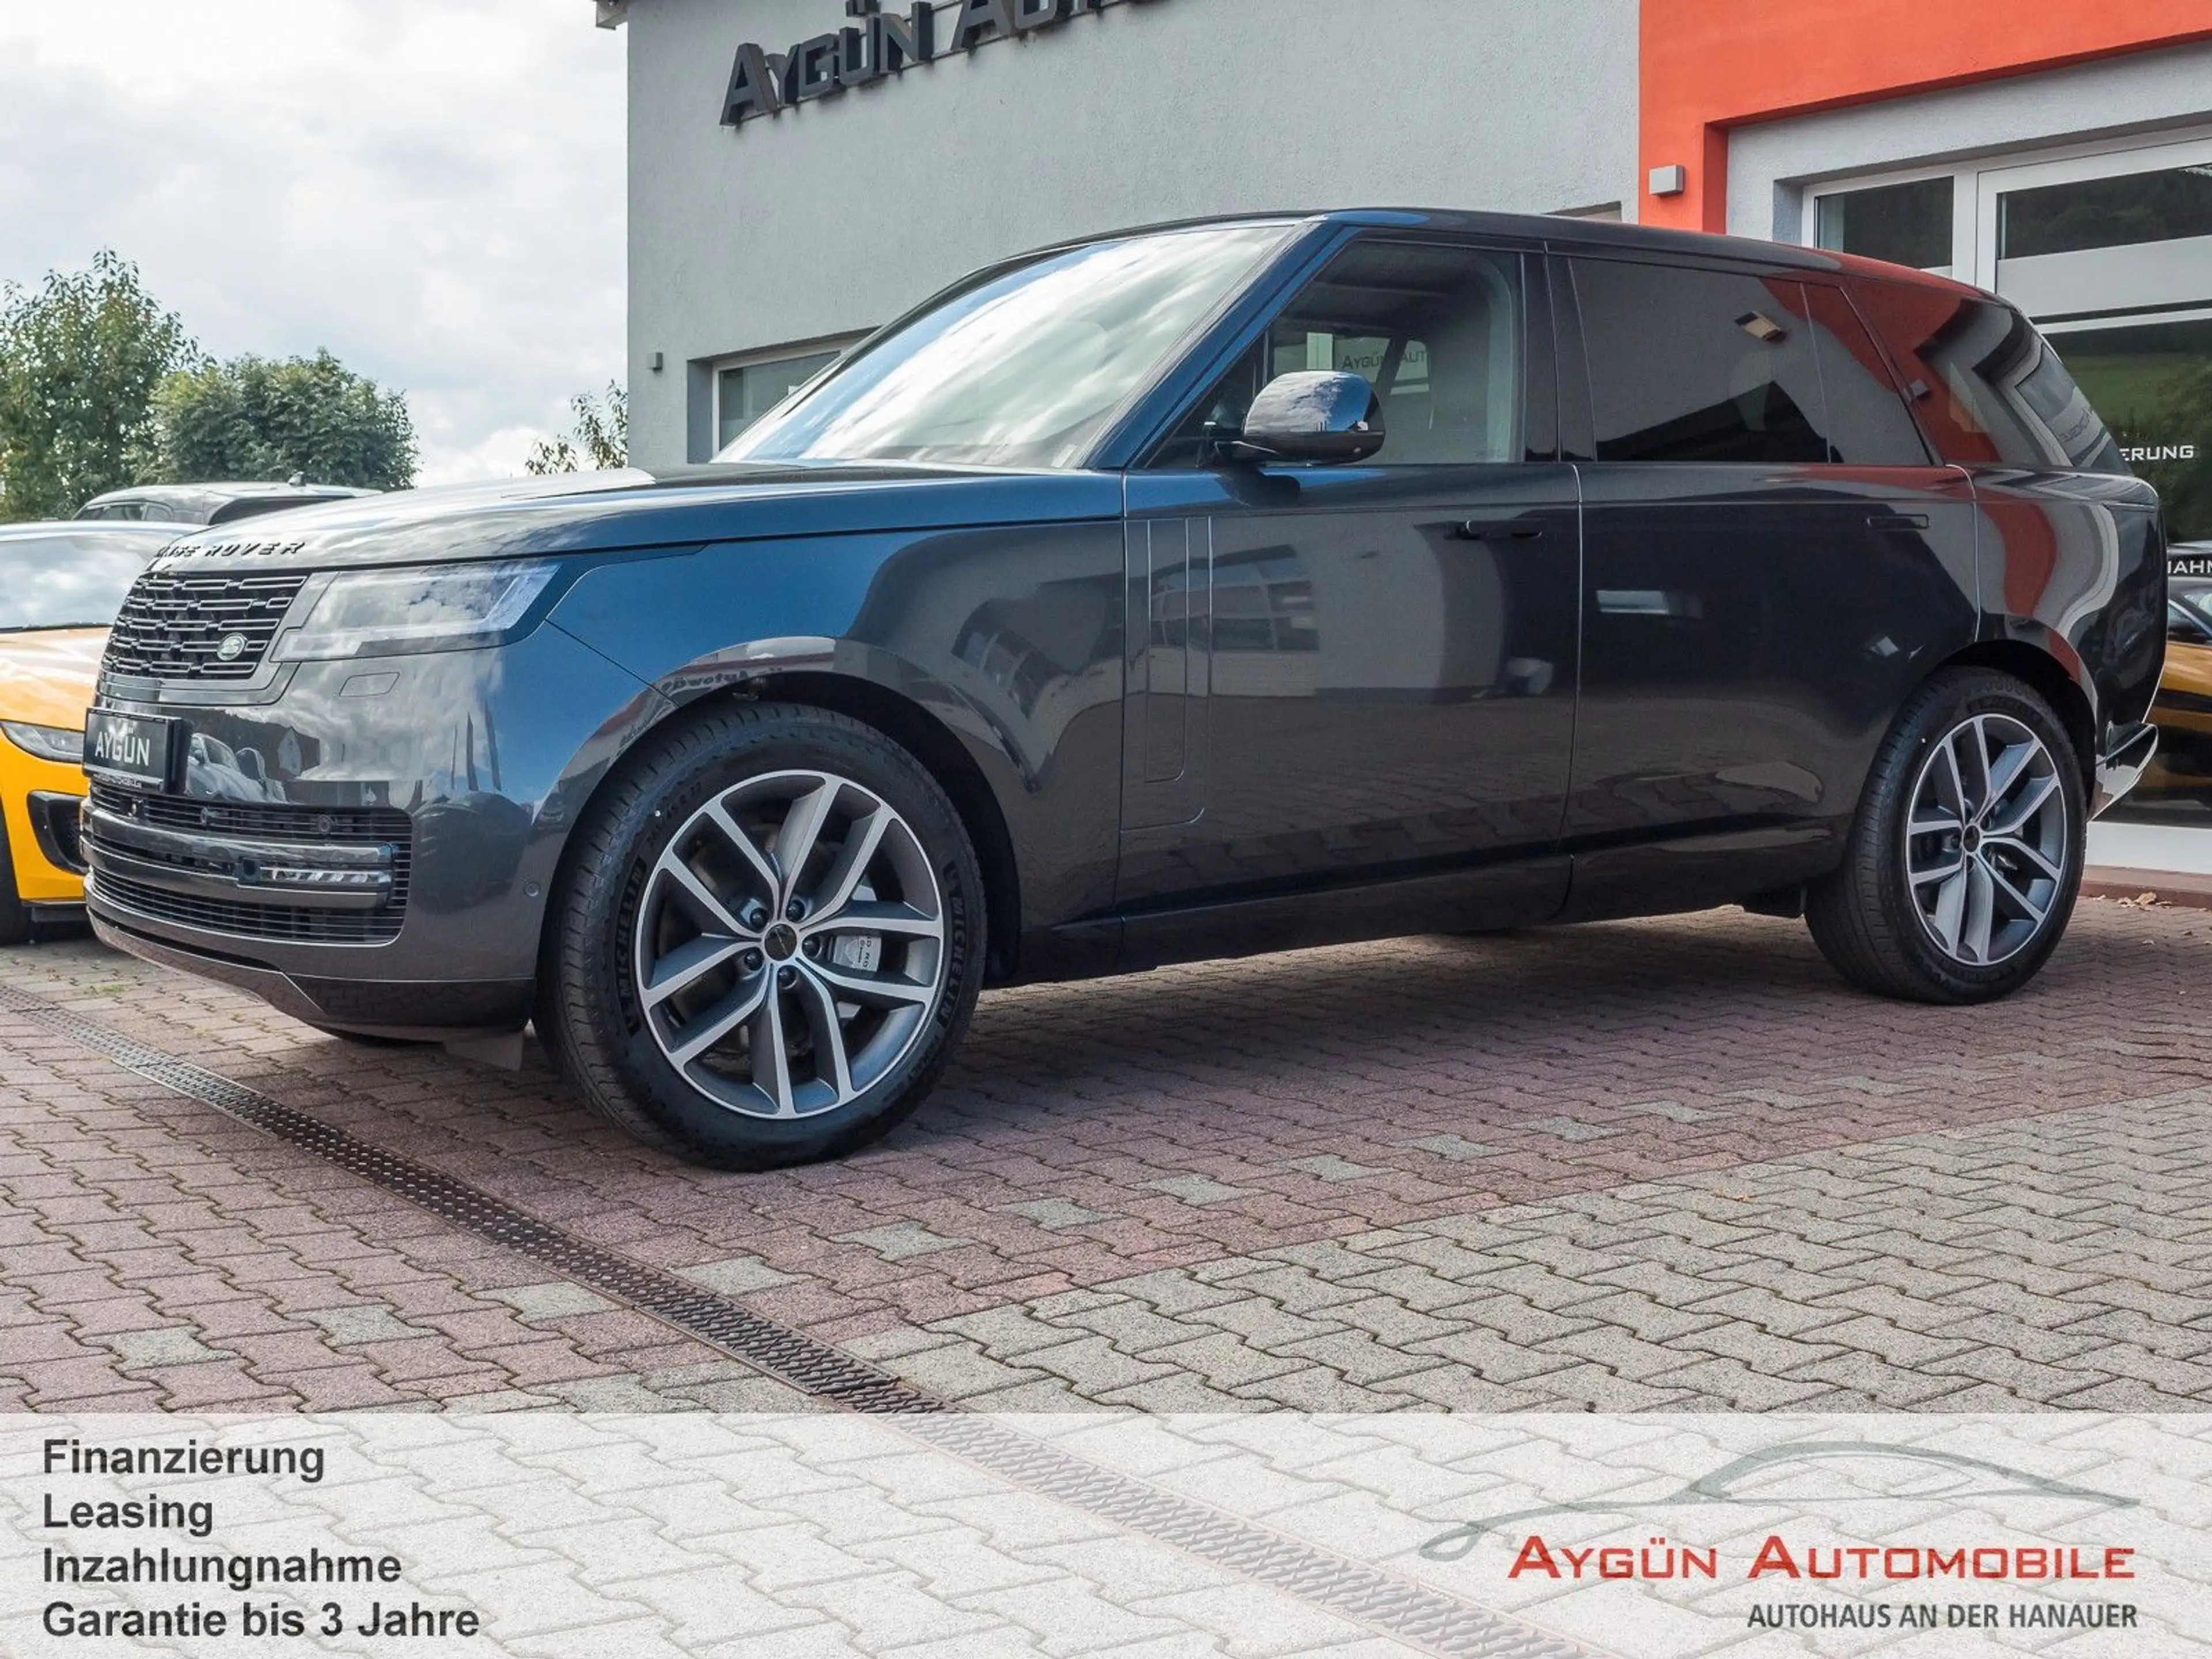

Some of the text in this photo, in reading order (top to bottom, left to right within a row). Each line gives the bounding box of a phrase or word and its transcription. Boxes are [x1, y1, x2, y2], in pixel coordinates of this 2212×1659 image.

[719, 0, 934, 126] AYGÜN
[1342, 352, 1385, 369] AYGÜ
[204, 541, 306, 557] ROVER
[94, 726, 150, 767] AYGÜN
